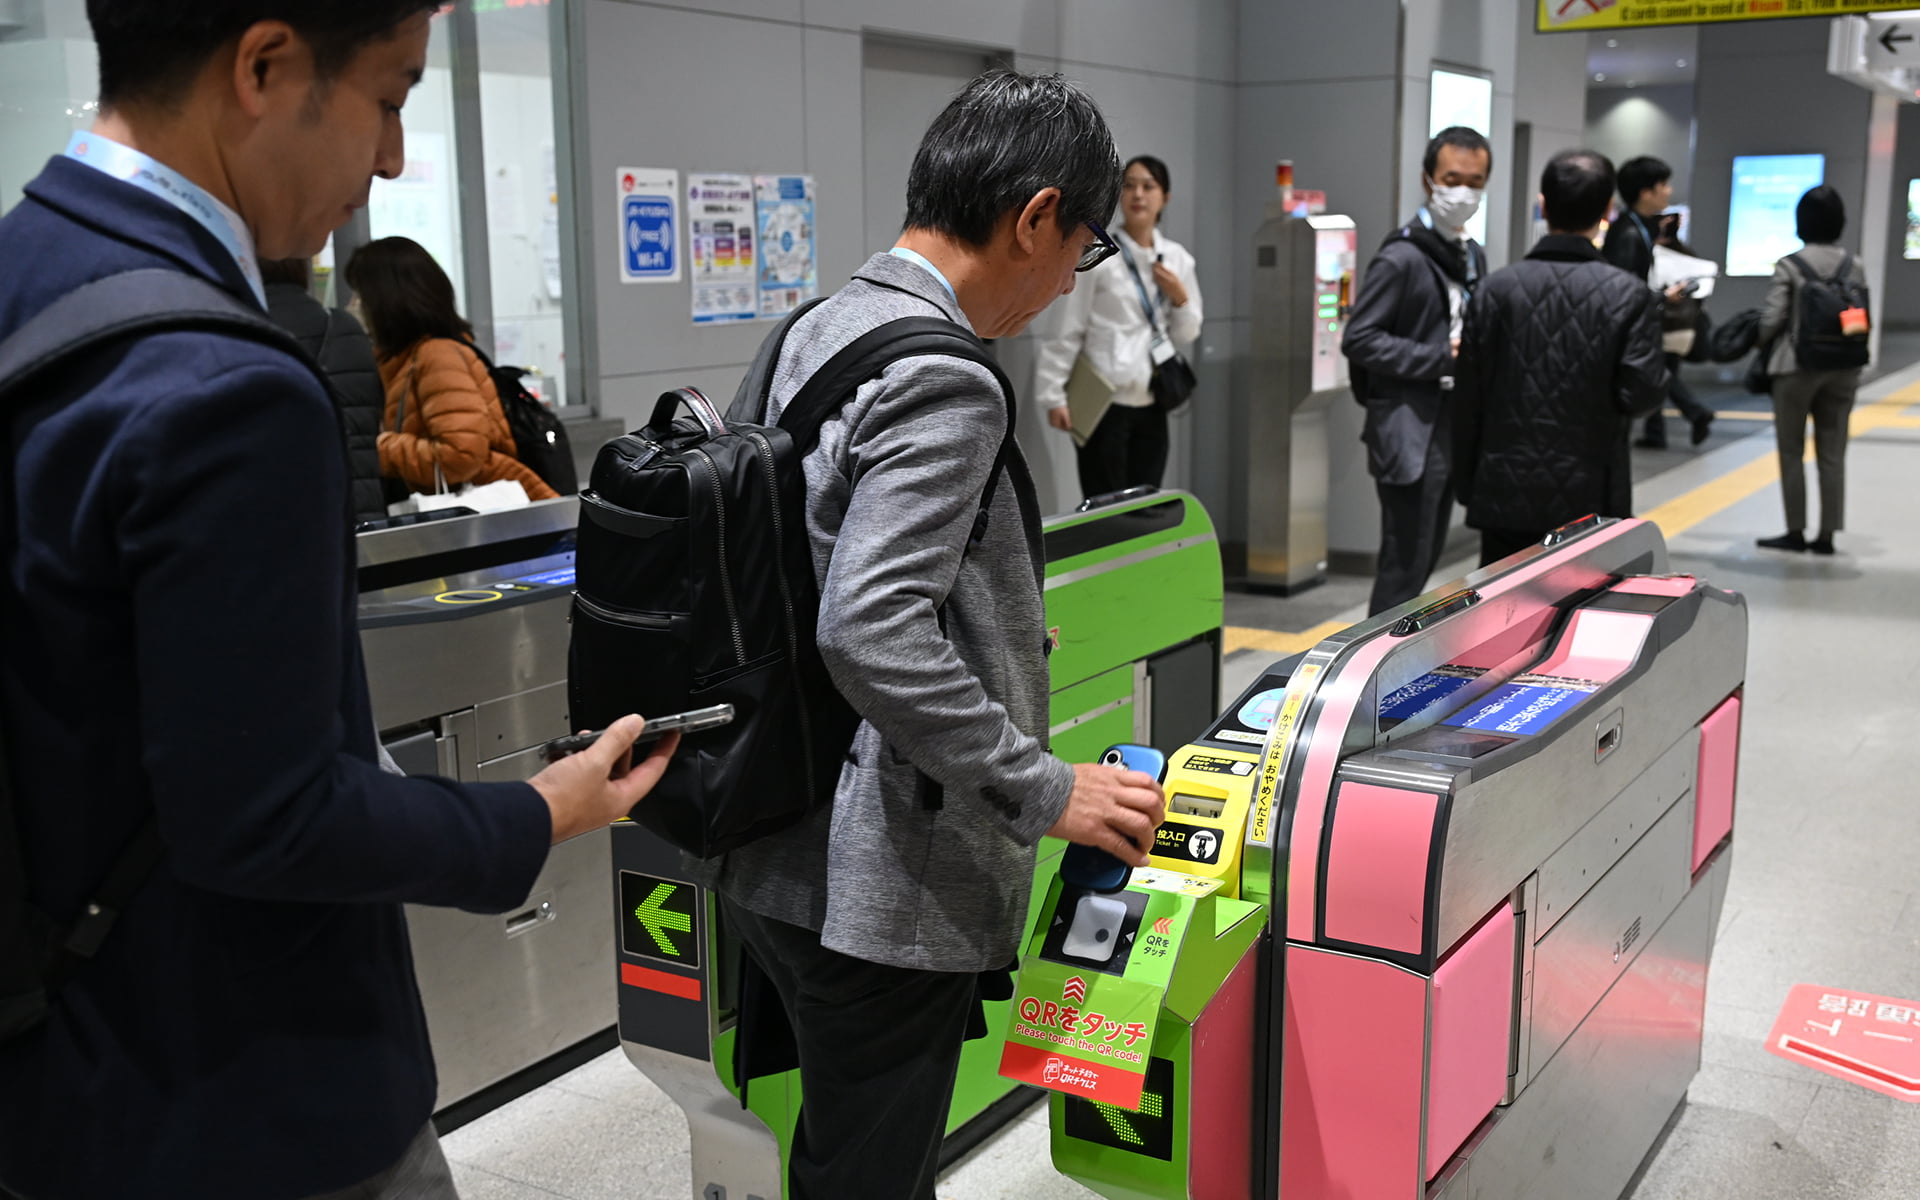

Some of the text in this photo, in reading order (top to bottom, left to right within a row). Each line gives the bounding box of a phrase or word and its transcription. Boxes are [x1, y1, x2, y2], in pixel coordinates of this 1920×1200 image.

[1660, 4, 1692, 18] cannot
[1695, 4, 1707, 15] be
[1711, 3, 1733, 15] used
[640, 230, 659, 243] FREE
[636, 252, 665, 267] Wi-Fi
[1254, 764, 1277, 837] おやめください
[1155, 839, 1171, 847] Ticket
[1146, 935, 1170, 948] QRを
[1143, 946, 1167, 958] タッチ
[1019, 996, 1147, 1047] QRをタッチ
[1015, 1023, 1143, 1063] Please touch the QR code!
[1063, 1064, 1100, 1079] ネット予約で
